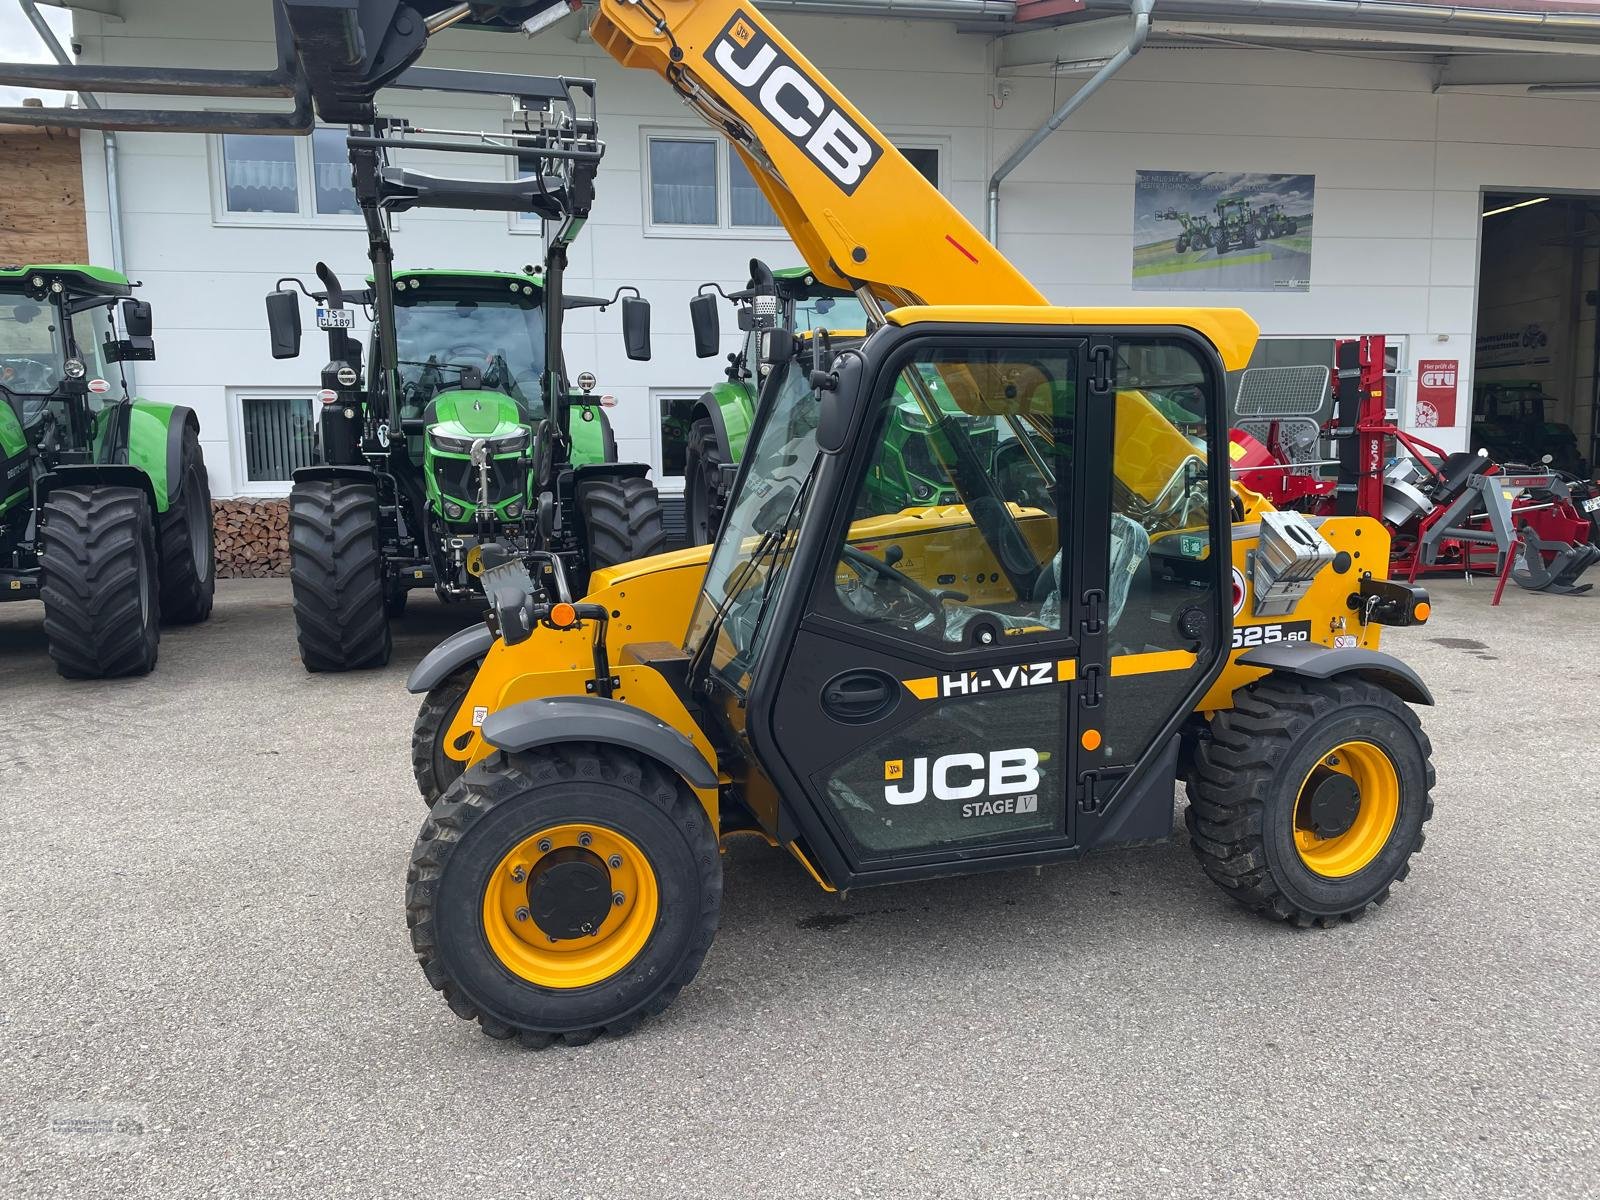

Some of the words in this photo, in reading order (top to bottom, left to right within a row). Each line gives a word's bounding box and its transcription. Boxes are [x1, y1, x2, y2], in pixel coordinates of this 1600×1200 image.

[715, 39, 872, 184] JCB
[326, 310, 338, 318] TS
[320, 318, 332, 326] CL
[334, 319, 350, 327] 189
[1435, 363, 1447, 371] prüft
[884, 747, 1040, 806] JCB
[962, 799, 1014, 817] STAGE
[1022, 796, 1034, 810] V
